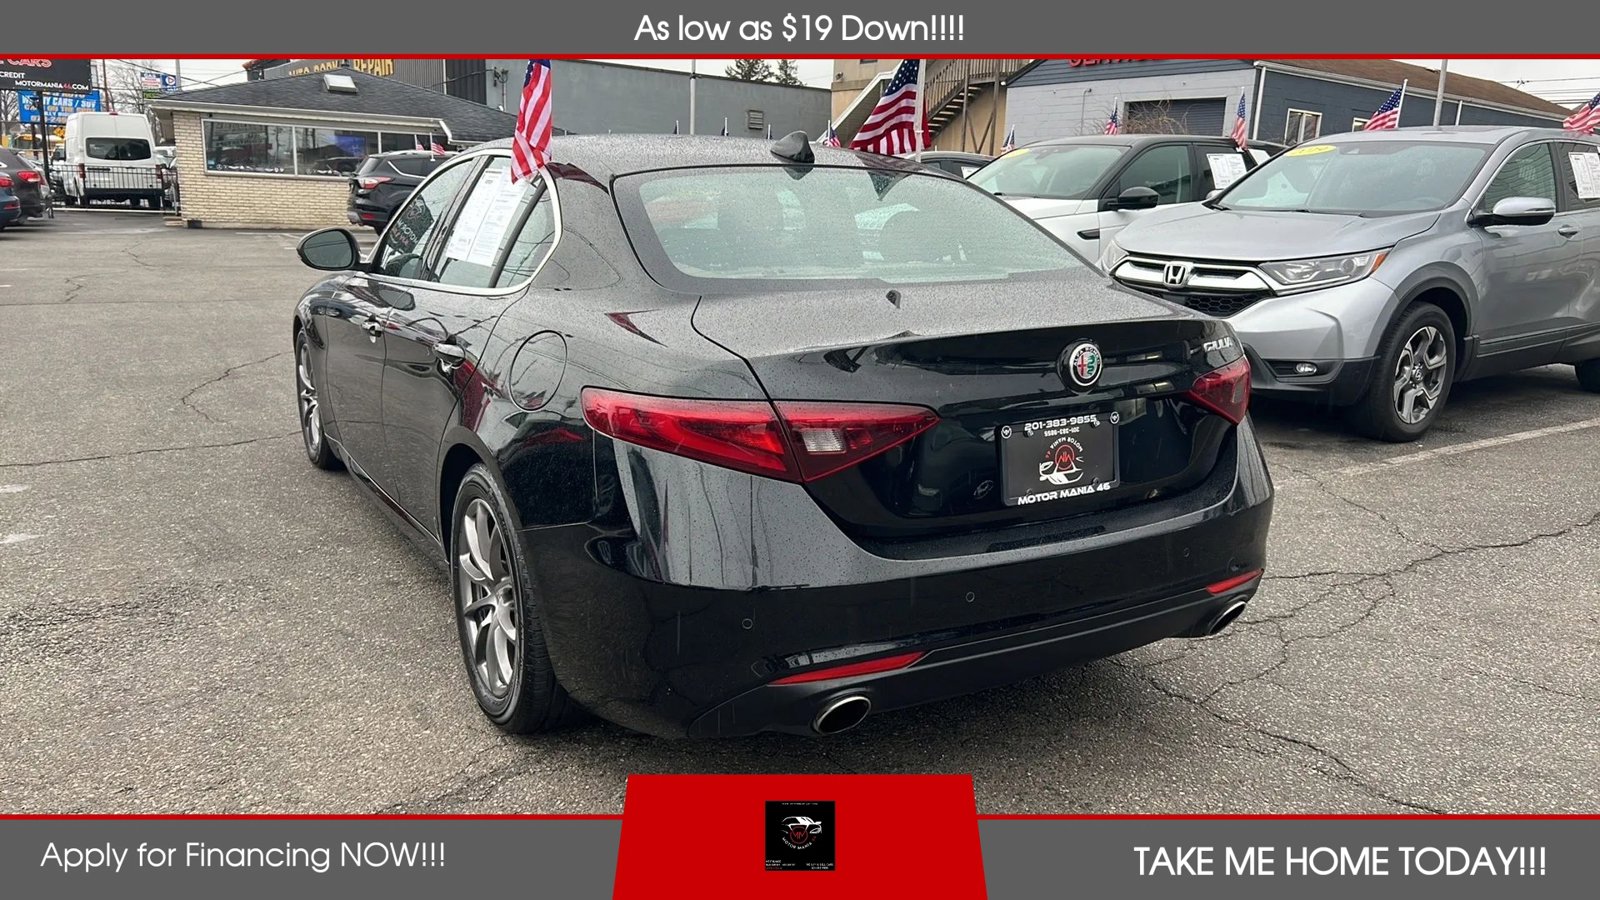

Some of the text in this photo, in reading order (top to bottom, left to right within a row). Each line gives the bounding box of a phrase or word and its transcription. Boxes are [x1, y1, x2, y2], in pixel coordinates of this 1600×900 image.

[1024, 414, 1097, 431] 201-383-9855
[1017, 482, 1111, 505] MOTOR MANIA 46
